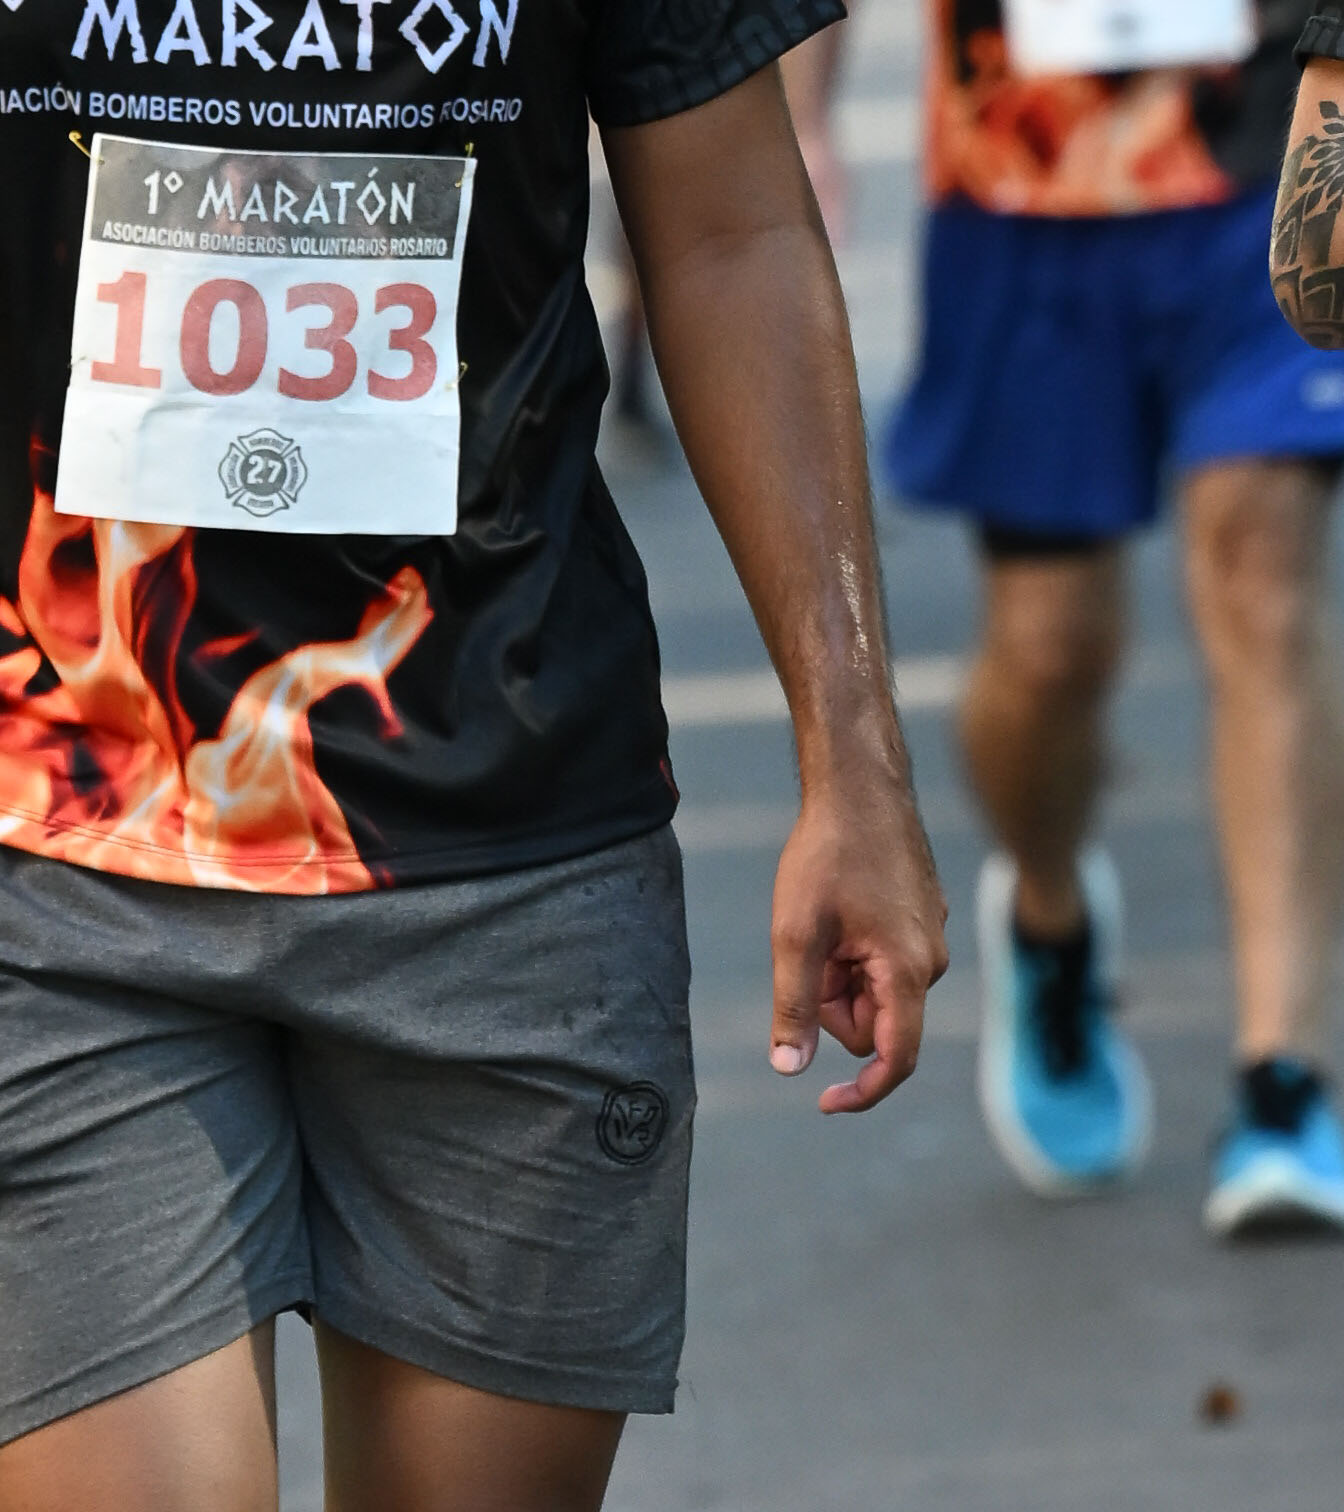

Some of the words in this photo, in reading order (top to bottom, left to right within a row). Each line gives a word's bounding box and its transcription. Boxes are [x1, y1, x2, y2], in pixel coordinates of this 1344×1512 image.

[89, 92, 241, 126] BOMBEROS
[249, 101, 435, 129] VOLUNTARIOS
[439, 98, 523, 125] ROSARIO
[197, 167, 415, 225] MARATÓN
[200, 234, 286, 255] BOMBEROS
[291, 236, 386, 257] VOLUNTARIOS
[389, 237, 448, 258] ROSARIO
[90, 271, 438, 402] 1033
[247, 455, 282, 484] 27
